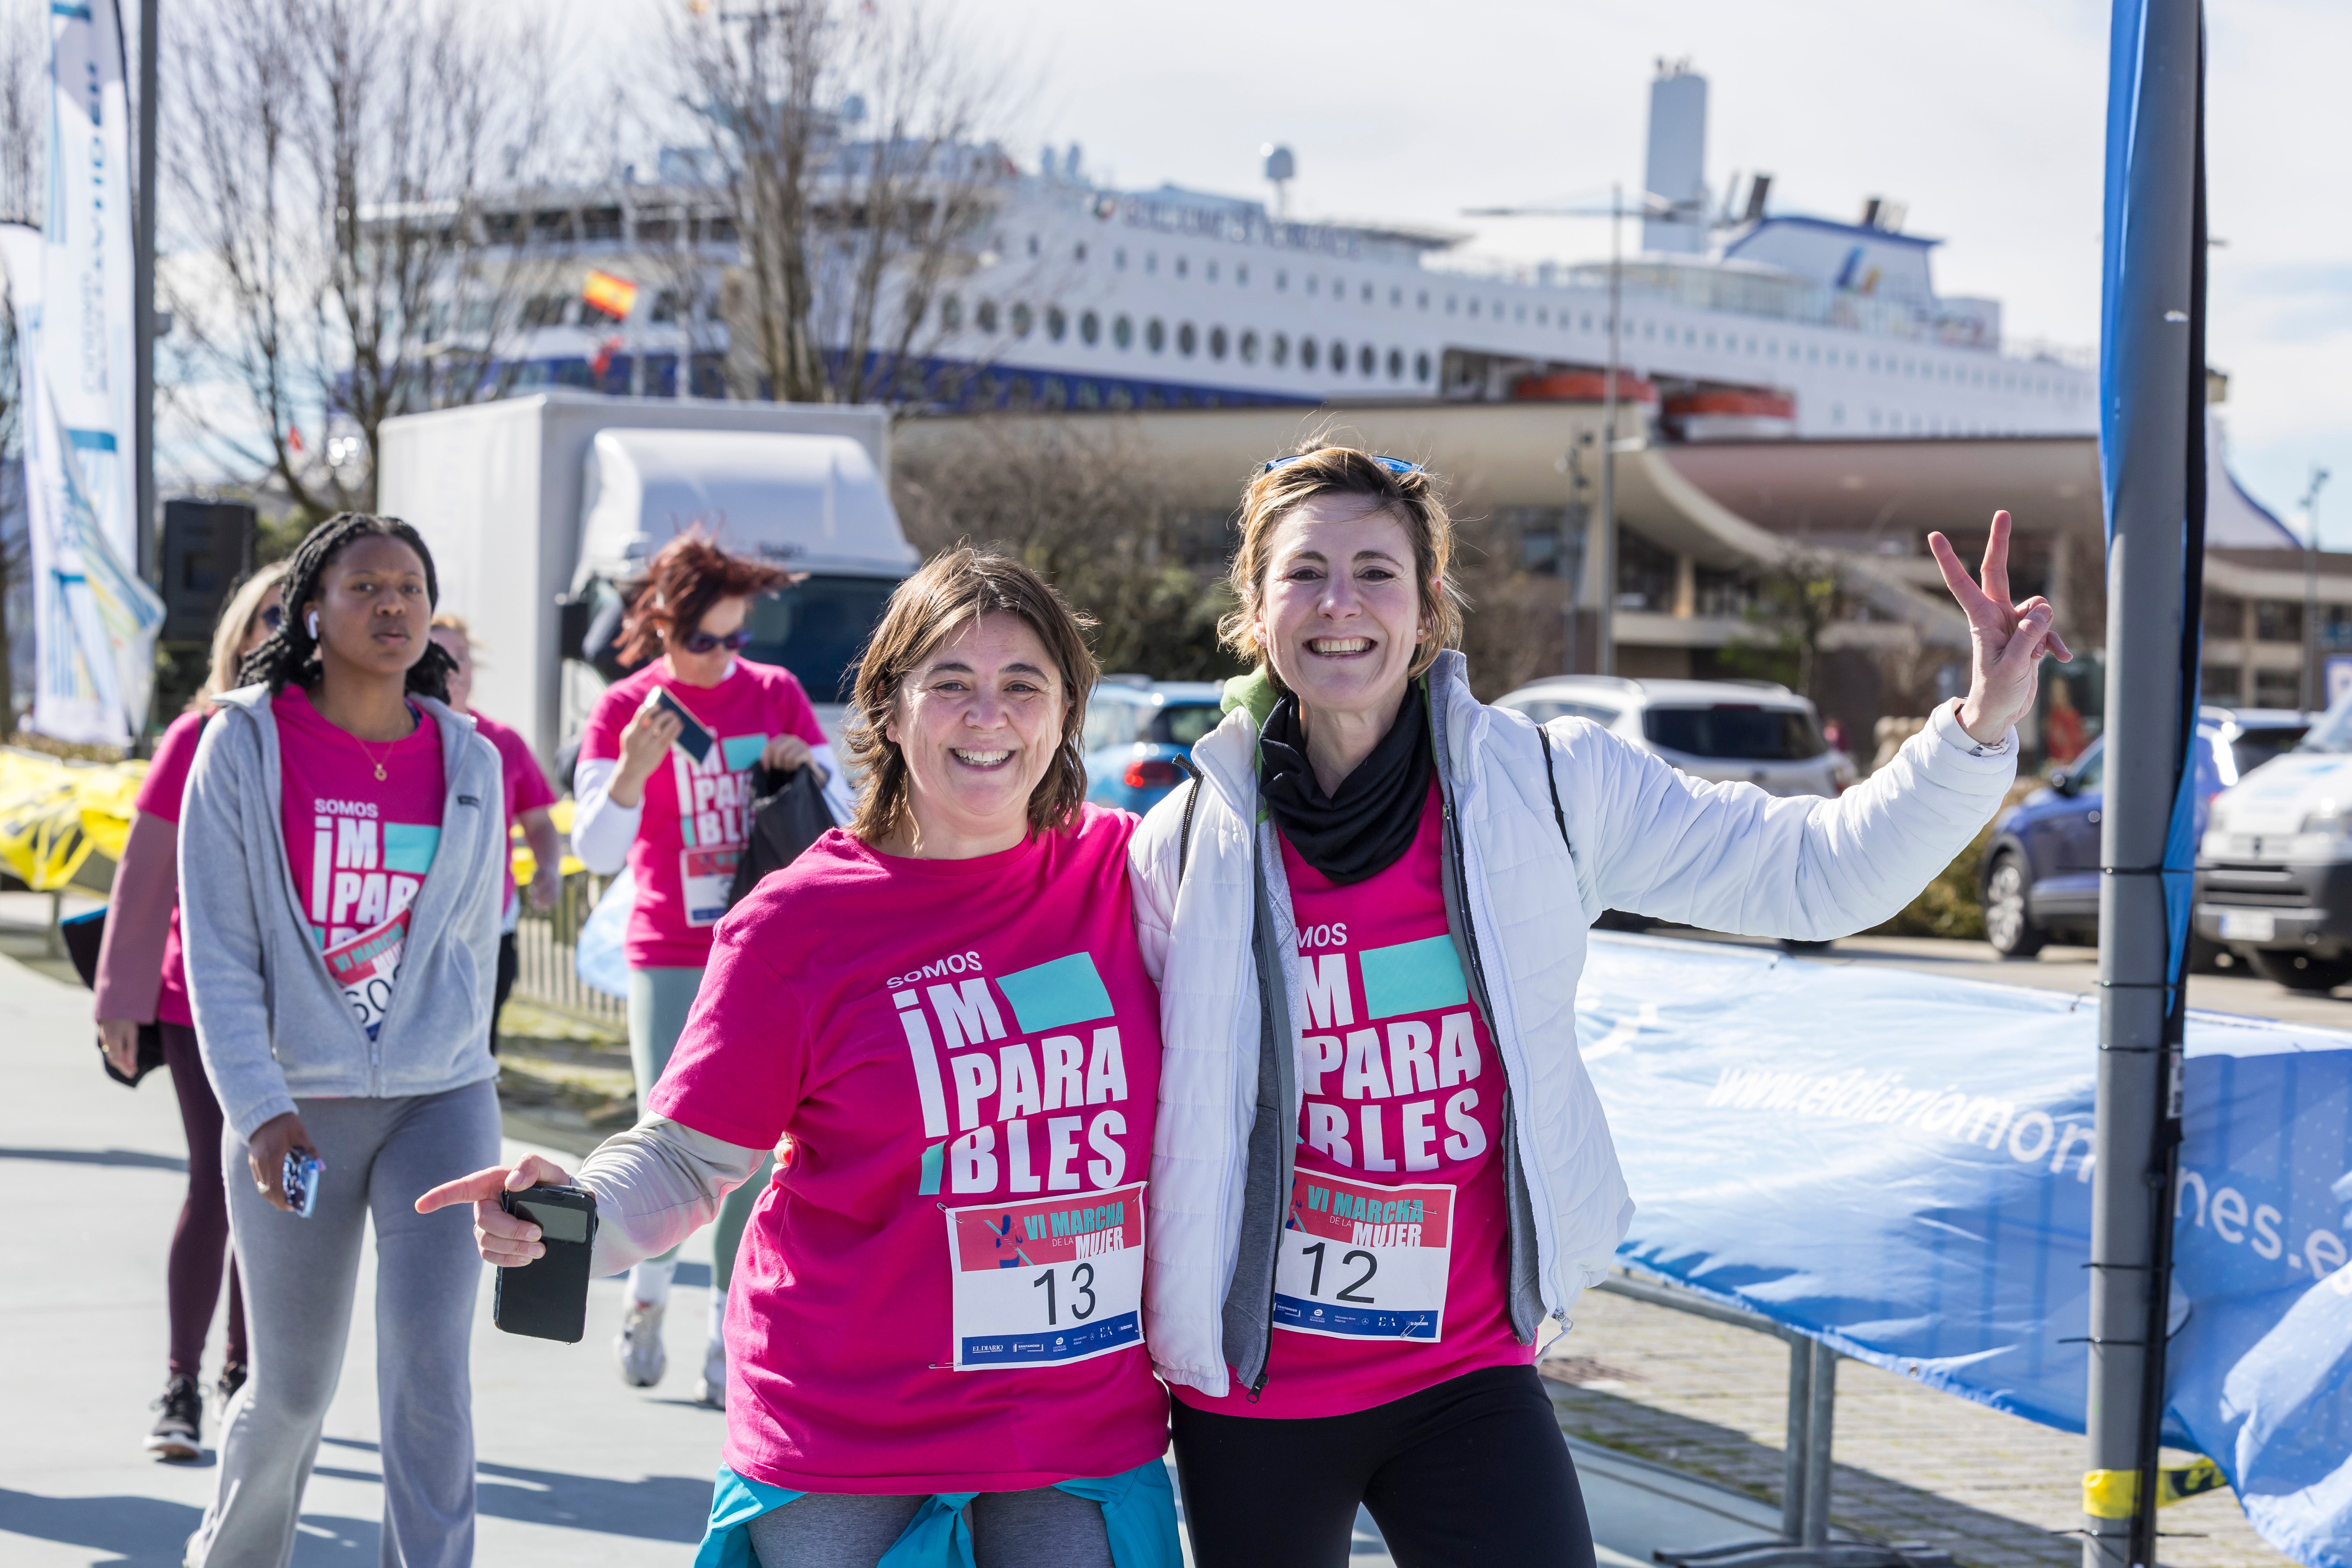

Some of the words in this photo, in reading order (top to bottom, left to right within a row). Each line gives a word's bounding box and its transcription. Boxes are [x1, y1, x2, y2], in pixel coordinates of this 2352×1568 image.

[314, 799, 378, 818] SOMOS
[331, 871, 420, 925] PAR
[1296, 923, 1348, 948] MOS
[333, 954, 353, 972] VI
[887, 951, 982, 988] SOMOS
[345, 964, 402, 1024] 60
[1298, 953, 1355, 1030] M
[1302, 1011, 1481, 1099] PARA
[950, 1026, 1128, 1131] PARA
[950, 1110, 1127, 1194] BLES
[1024, 1214, 1047, 1240] VI
[1050, 1201, 1124, 1238] MARCHA
[1308, 1185, 1329, 1212] VI
[1333, 1192, 1423, 1224] MARCHA
[1052, 1238, 1063, 1247] DE
[1064, 1237, 1074, 1245] LA
[1075, 1226, 1125, 1261] MUJER
[1330, 1216, 1341, 1224] DE
[1342, 1220, 1352, 1228] LA
[1352, 1222, 1422, 1248] MUJER
[1034, 1263, 1096, 1325] 13
[1302, 1242, 1378, 1304] 12
